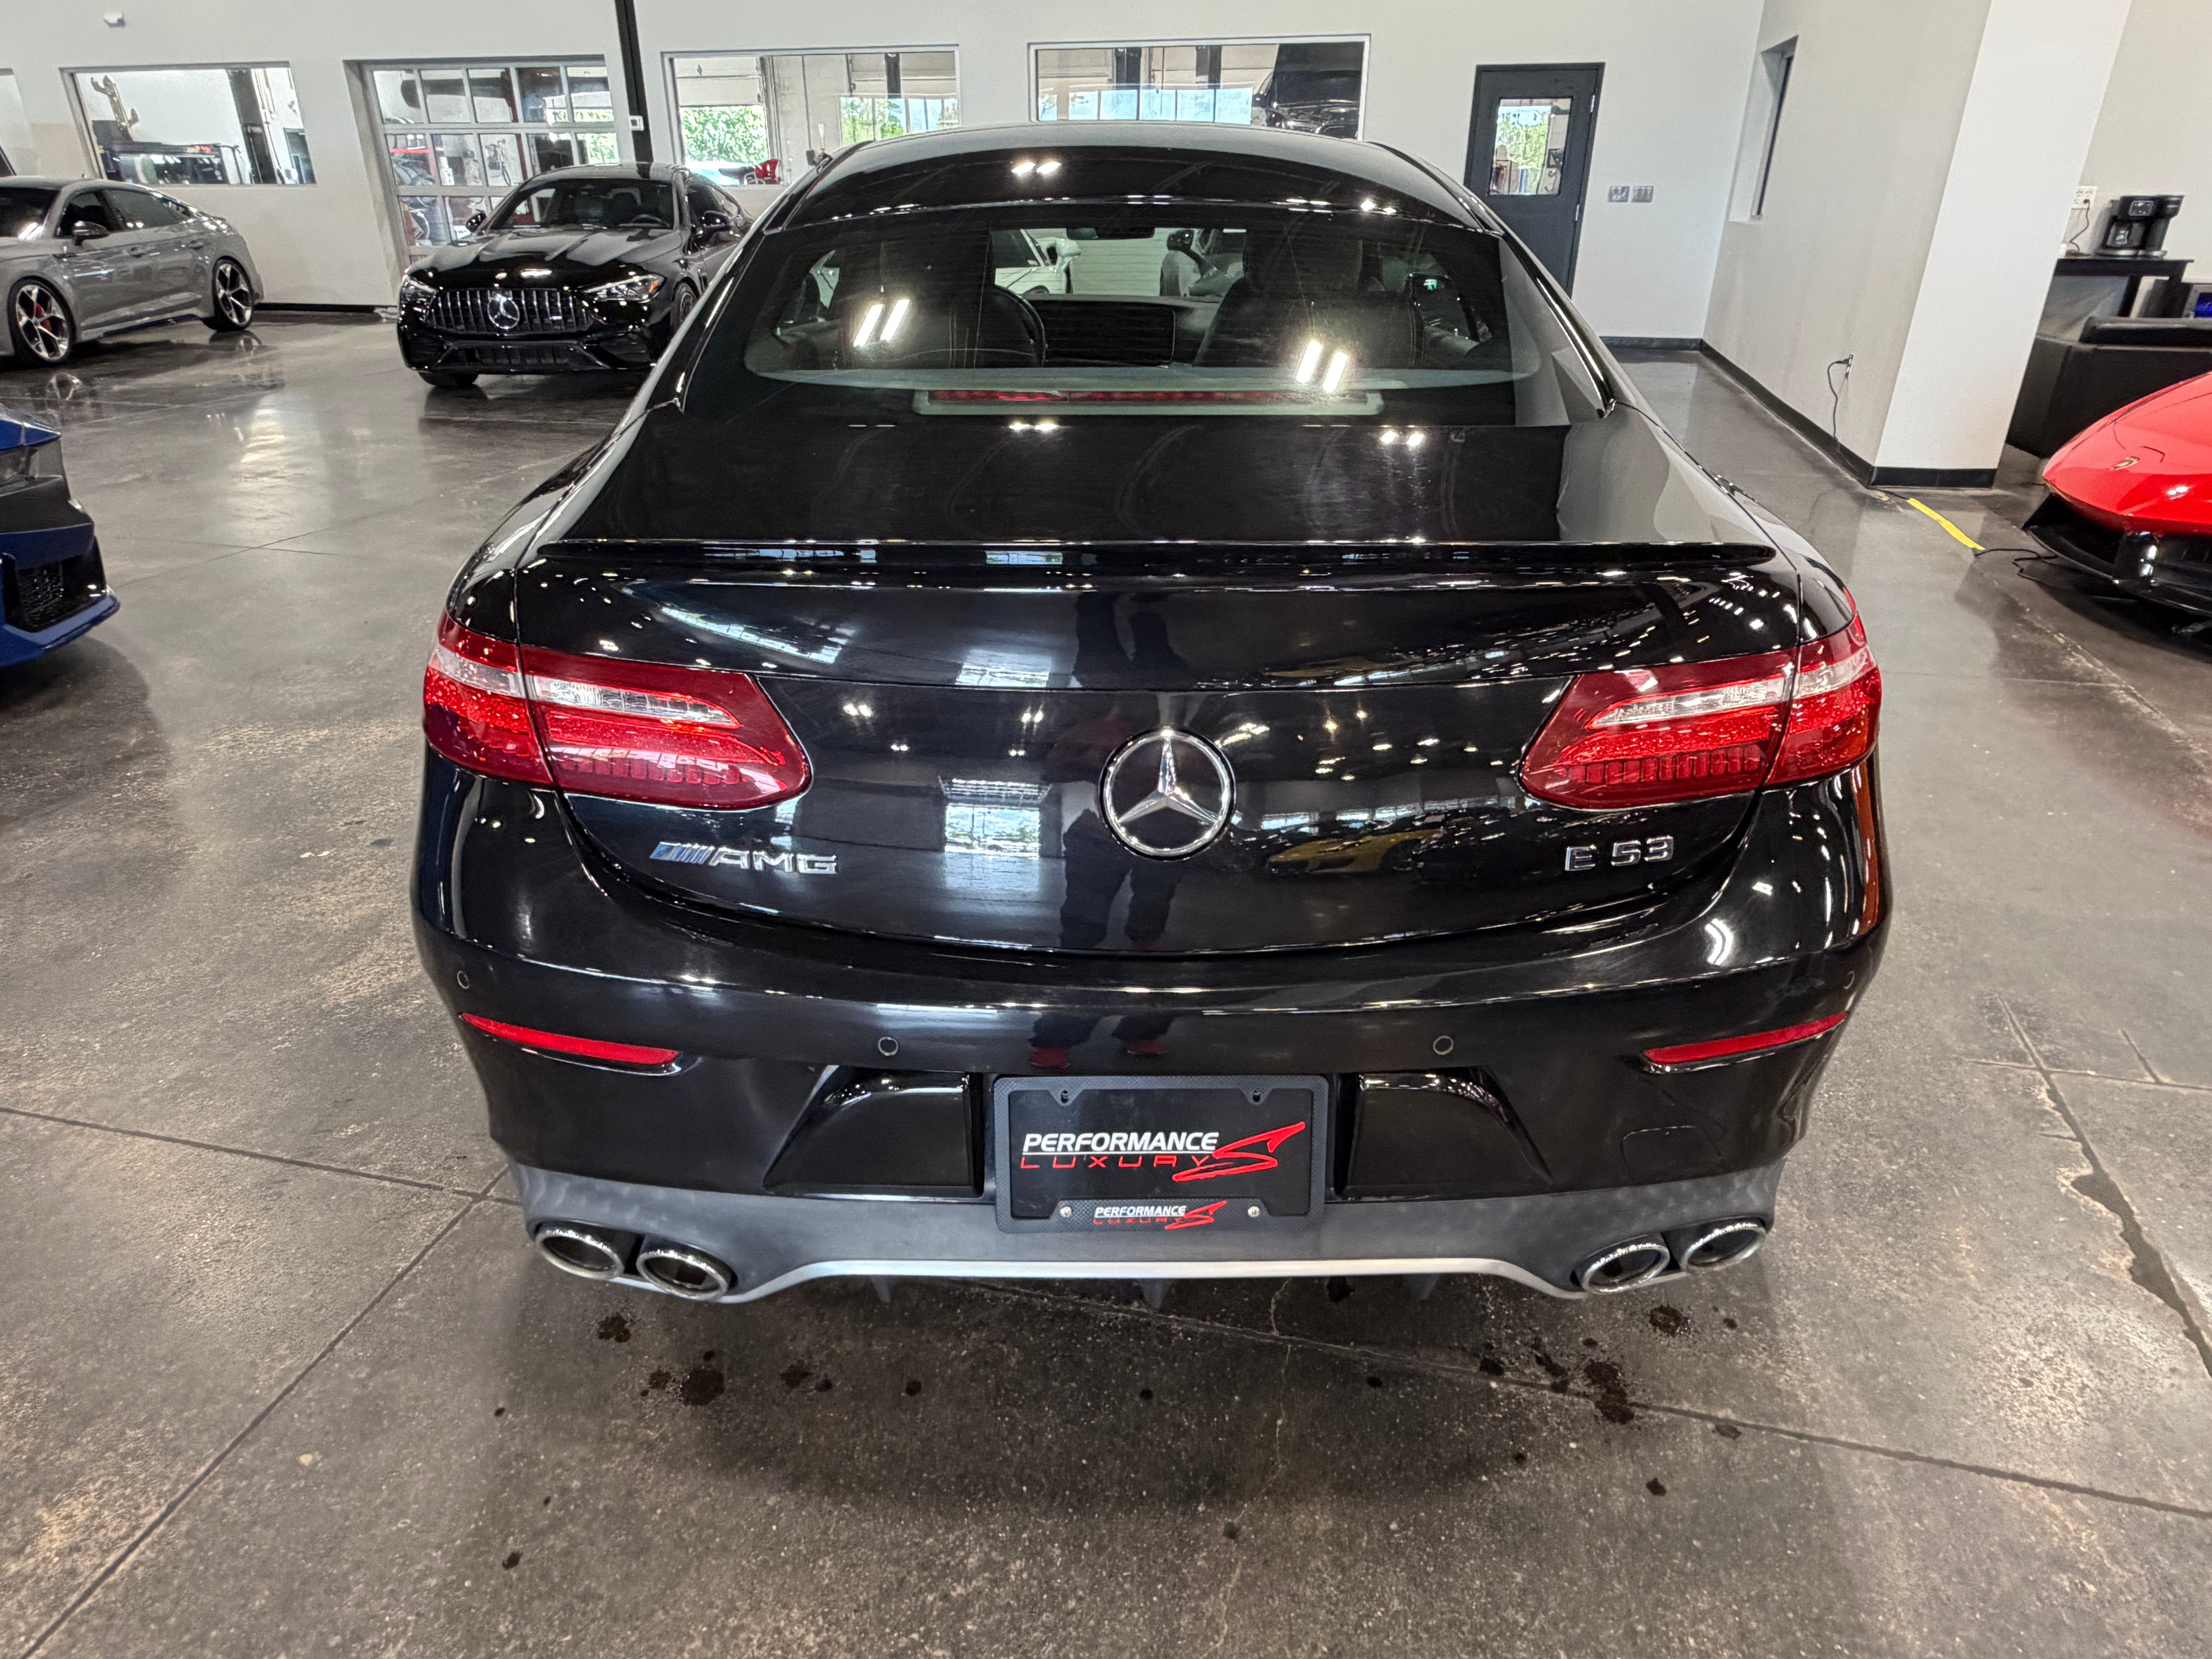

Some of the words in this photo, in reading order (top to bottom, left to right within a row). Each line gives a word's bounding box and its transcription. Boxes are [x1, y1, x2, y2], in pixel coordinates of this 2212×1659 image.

[1565, 845, 1596, 871] E
[1611, 835, 1674, 866] 53
[1023, 1132, 1219, 1152] PERFORMANCE
[1020, 1156, 1210, 1169] LUXURY
[1095, 1206, 1187, 1217] PERFORMANCE
